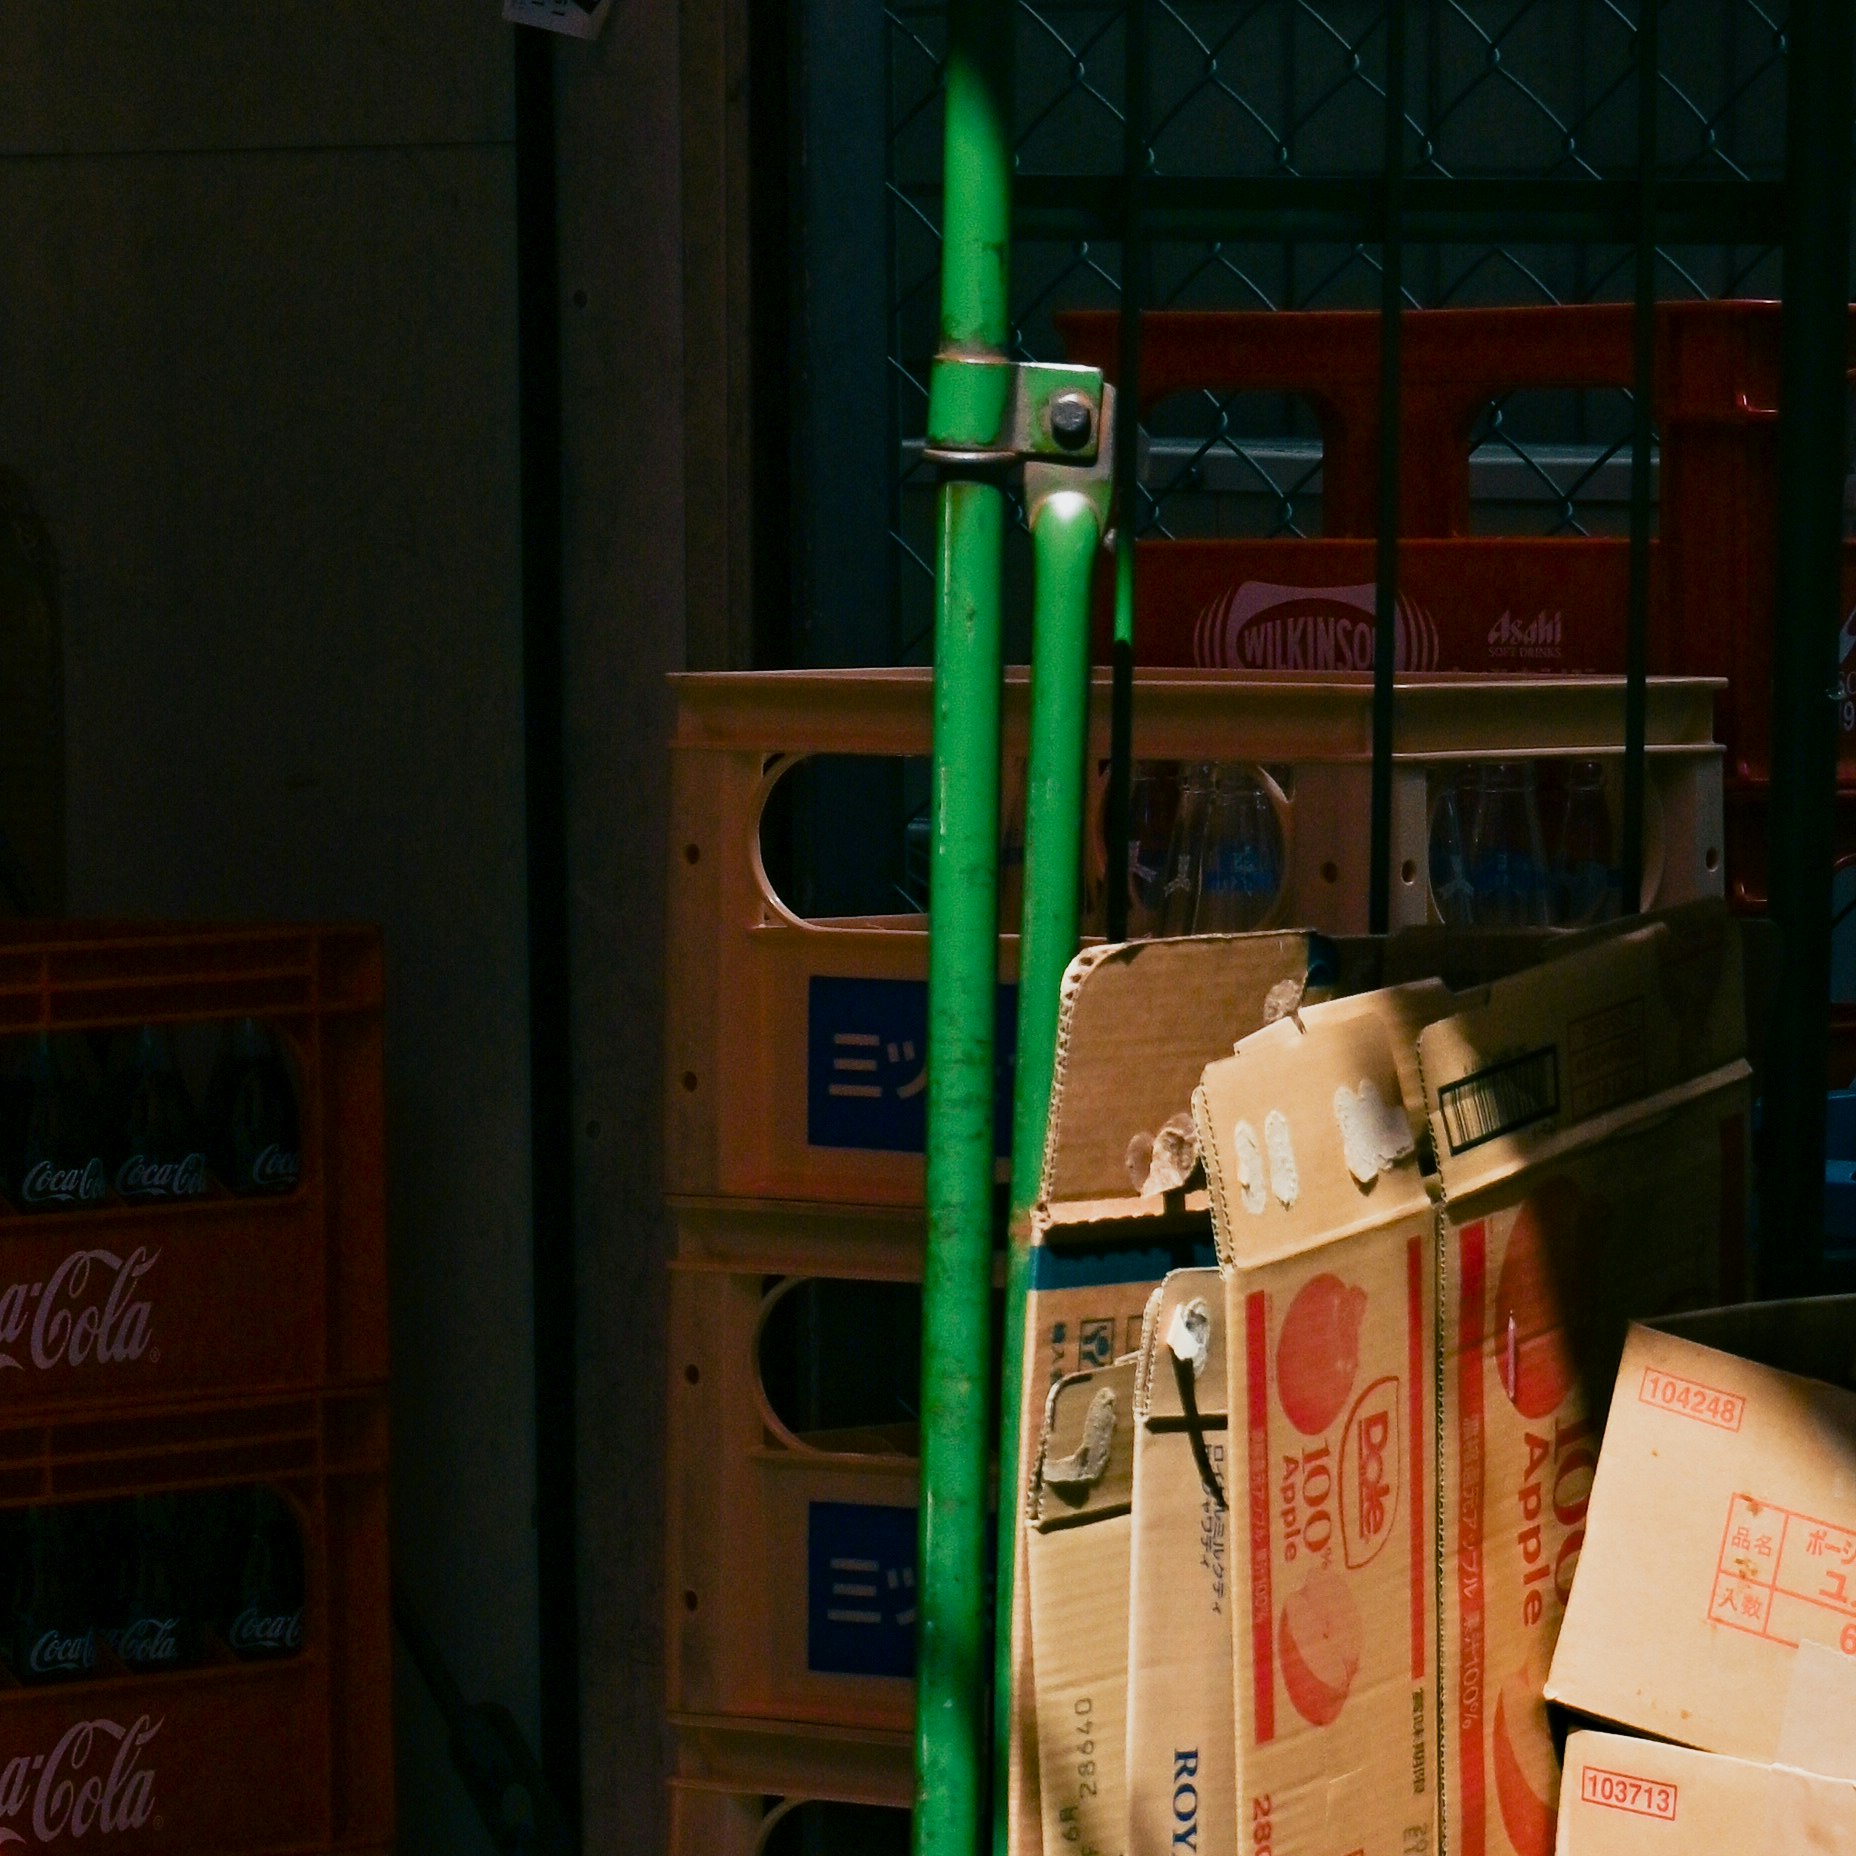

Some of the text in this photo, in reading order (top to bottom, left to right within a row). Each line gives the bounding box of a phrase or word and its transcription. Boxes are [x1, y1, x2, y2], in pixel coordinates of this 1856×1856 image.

[1244, 616, 1375, 671] WILKINSO
[1487, 608, 1562, 645] Asahi
[1647, 1376, 1737, 1425] 104248
[1357, 1410, 1389, 1541] Dole
[1282, 1454, 1301, 1563] Apple
[1517, 1431, 1550, 1628] Apple
[1731, 1526, 1773, 1558] 品名
[1717, 1588, 1761, 1619] 入数
[1075, 1696, 1098, 1799] 28640
[1586, 1773, 1671, 1813] 103713
